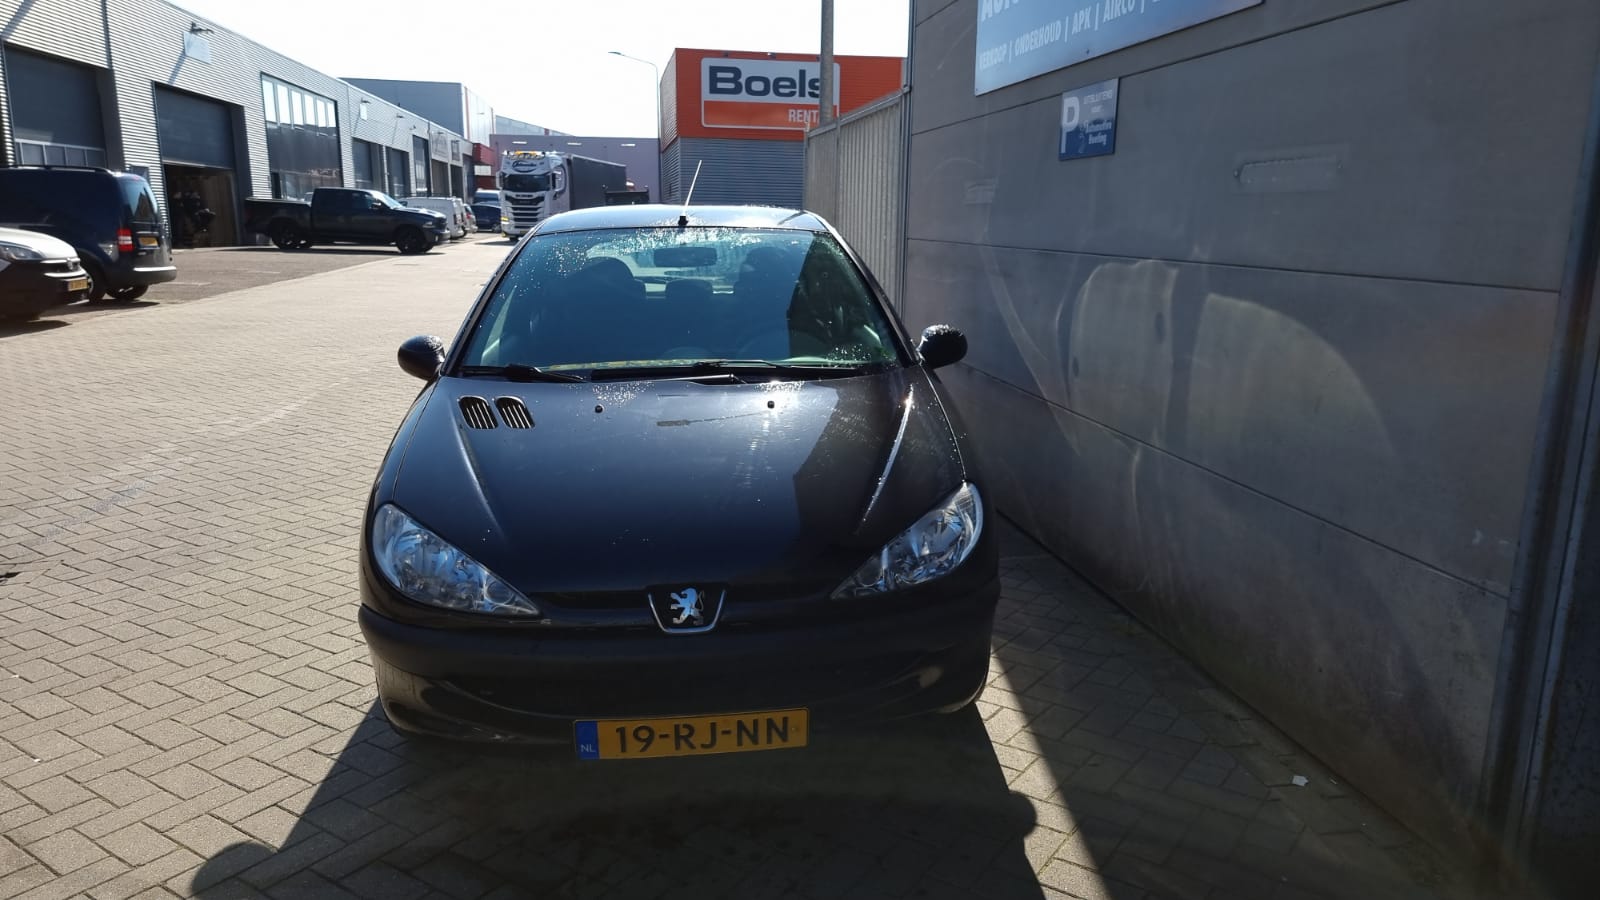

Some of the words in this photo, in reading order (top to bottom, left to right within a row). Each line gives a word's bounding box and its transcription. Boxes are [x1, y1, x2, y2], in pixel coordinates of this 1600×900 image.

[1014, 20, 1062, 56] ONDERHOUD
[1071, 6, 1092, 35] APK
[710, 66, 820, 98] Boels
[788, 108, 820, 124] RENT
[1061, 96, 1080, 153] P
[580, 743, 596, 753] NL
[615, 716, 790, 753] 19-RJ-NN
